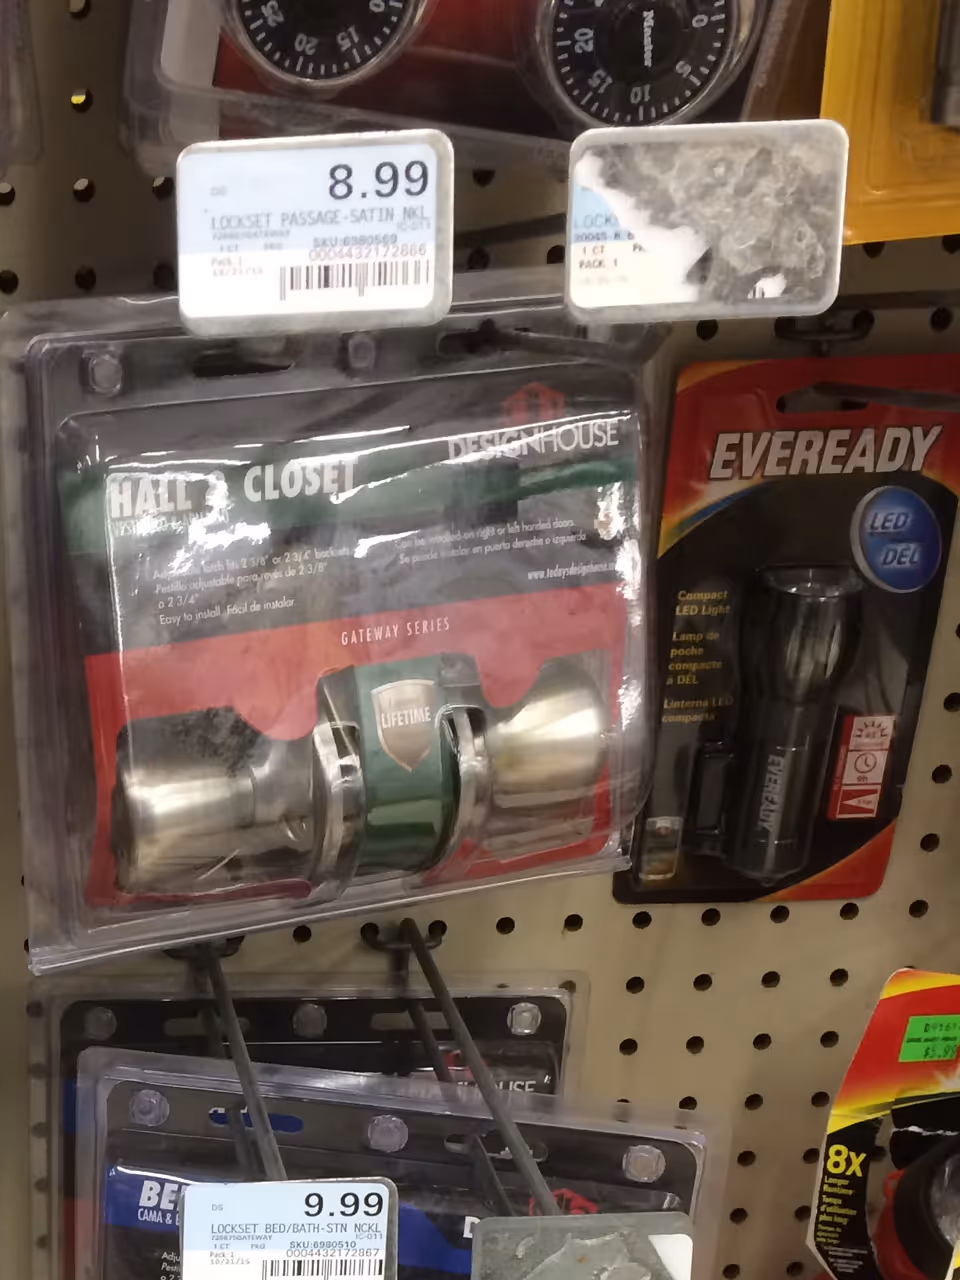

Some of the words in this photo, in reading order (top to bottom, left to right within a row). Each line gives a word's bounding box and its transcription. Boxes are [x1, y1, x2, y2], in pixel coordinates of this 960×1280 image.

[573, 27, 595, 54] 20
[642, 10, 653, 67] Master
[328, 160, 429, 200] 8.99
[211, 214, 273, 232] LOCKSET
[280, 206, 395, 227] PASSAGE-SATIN
[403, 205, 431, 221] NKL
[708, 424, 944, 480] EVEREADY
[110, 478, 192, 520] HALL
[243, 455, 359, 503] CLOSET
[867, 511, 912, 531] LED
[881, 543, 921, 567] DEL
[677, 589, 729, 602] Compact
[675, 604, 698, 616] LED
[701, 603, 731, 616] Light
[341, 623, 399, 646] GATEWAY
[406, 616, 450, 637] SERIES
[380, 705, 432, 730] LIFETIME
[757, 754, 786, 834] EVEREADY
[137, 1208, 163, 1224] CAMA
[304, 1192, 384, 1218] 9.99
[211, 1223, 259, 1234] LOCKSET
[265, 1222, 348, 1235] BED/BATH-STN
[354, 1223, 382, 1234] NCKL
[286, 1248, 381, 1258] 0004432172867
[289, 1240, 357, 1250] SKU:6980510
